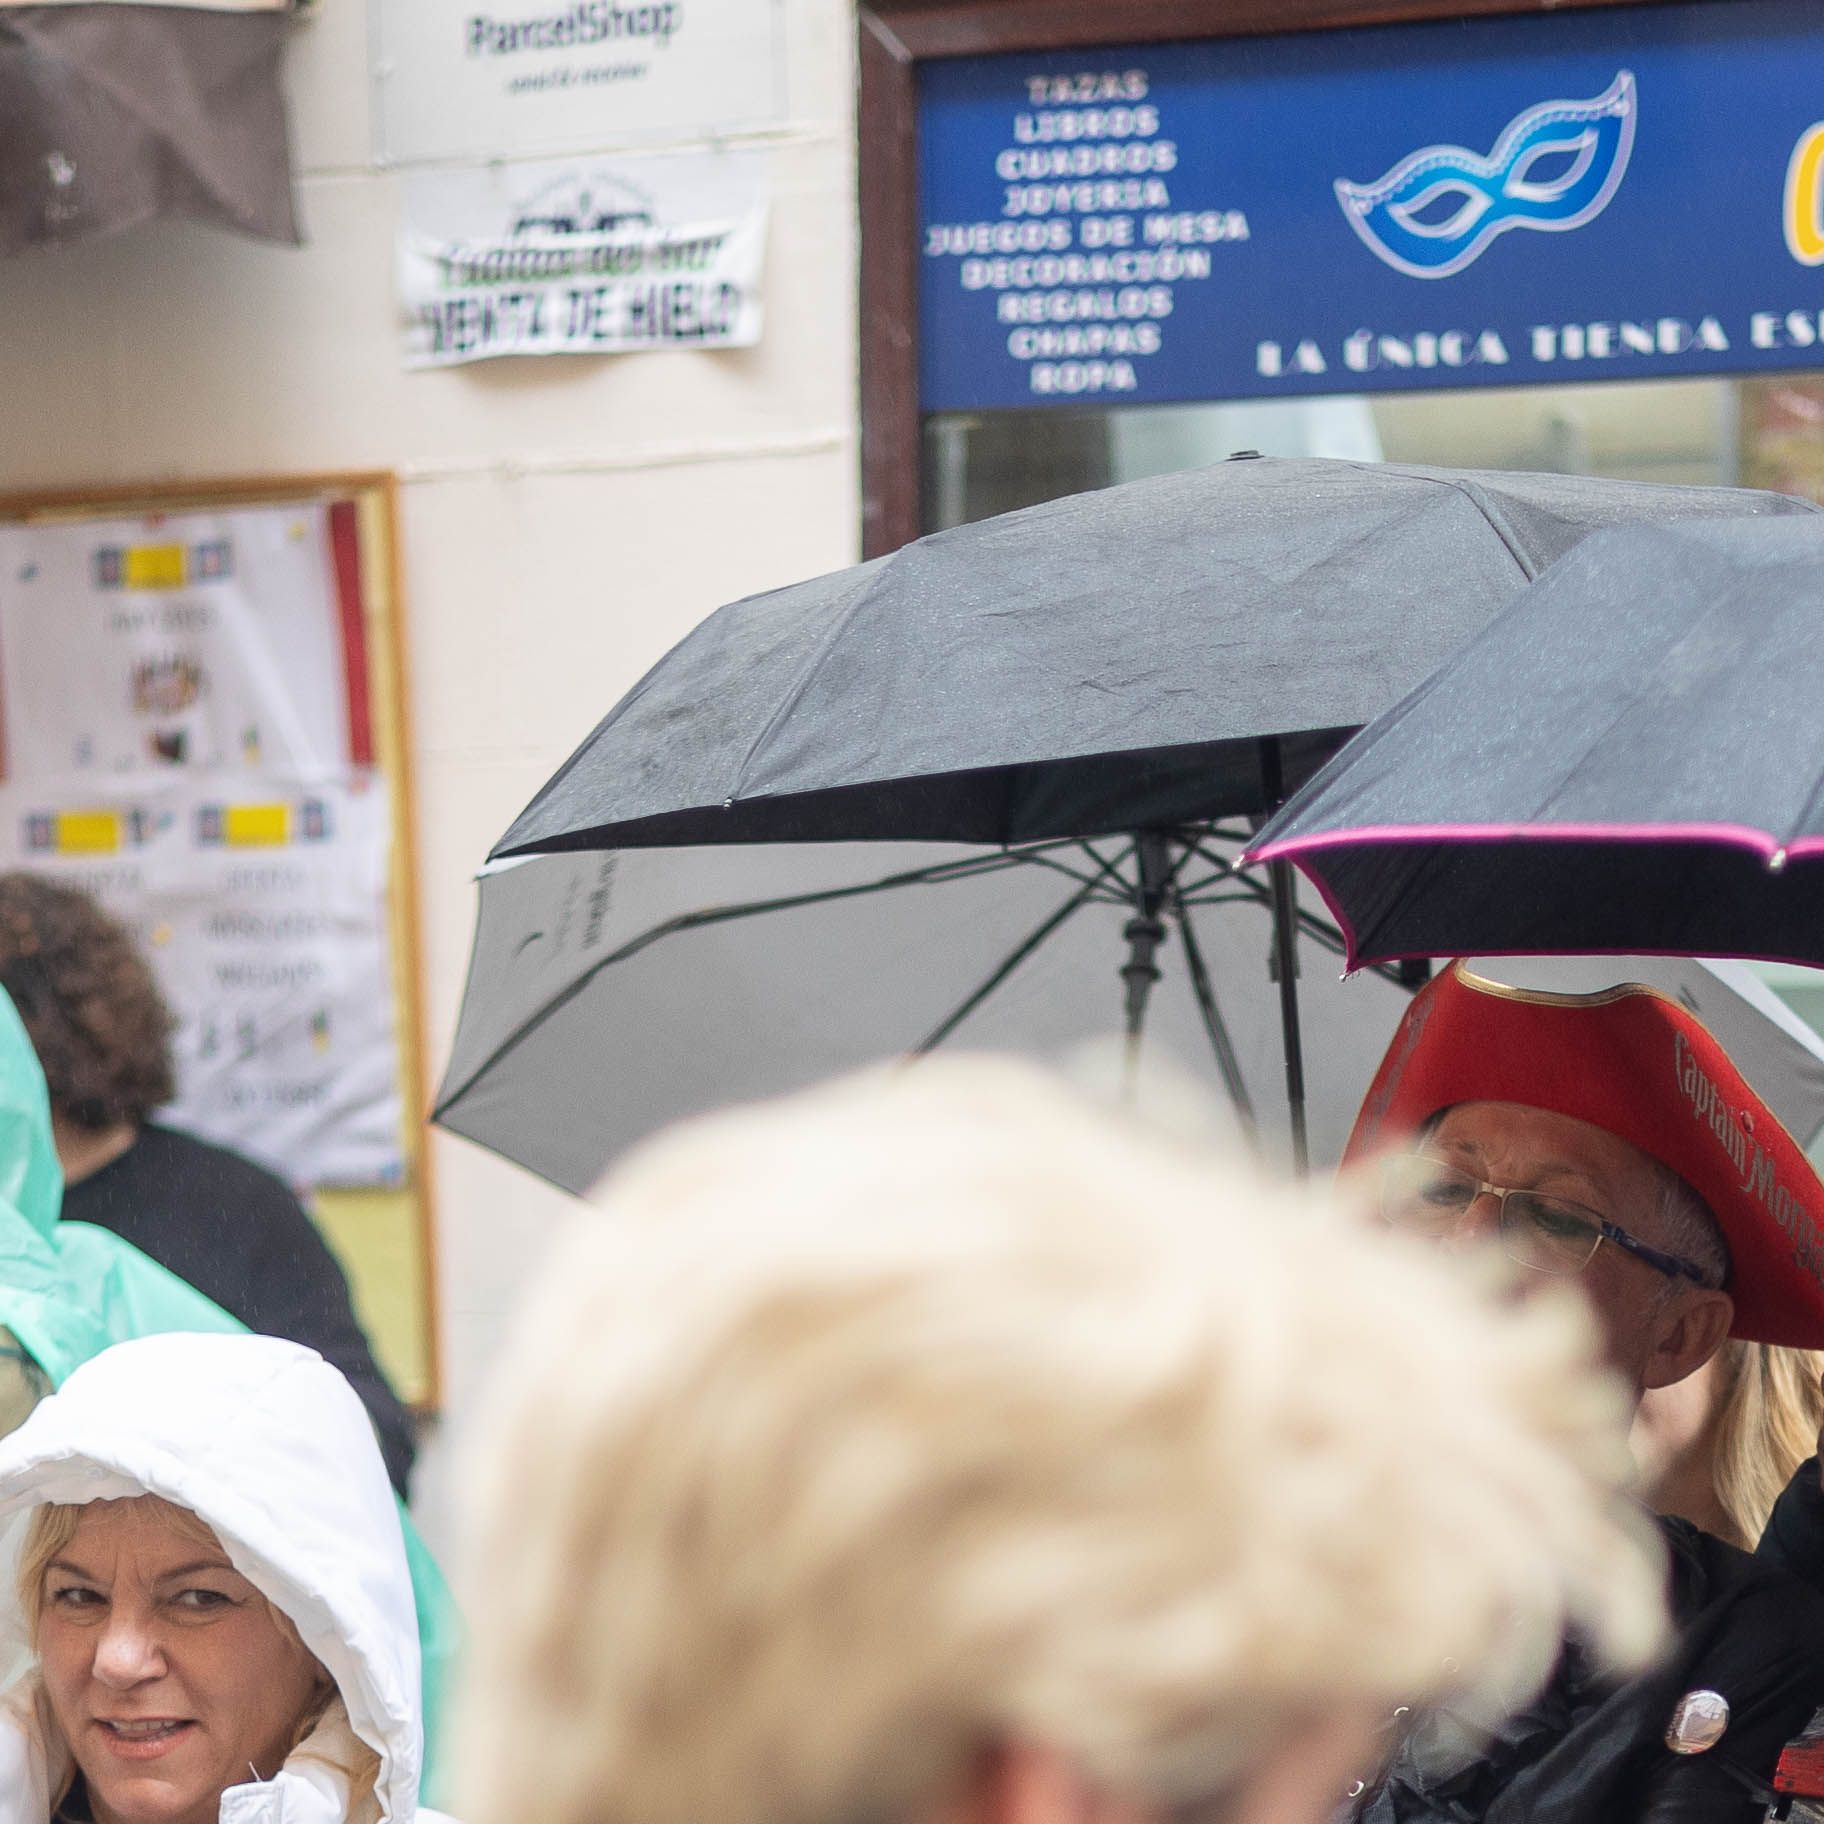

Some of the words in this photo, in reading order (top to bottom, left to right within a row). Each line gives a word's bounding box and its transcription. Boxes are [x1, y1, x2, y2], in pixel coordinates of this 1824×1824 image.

[467, 1, 680, 56] ParcelShop
[1026, 69, 1149, 105] TAZAS
[1014, 104, 1160, 144] LIBROS
[995, 139, 1178, 181] CUADROS
[924, 217, 1073, 256] JUEGOS
[1080, 214, 1135, 248] DE
[1143, 209, 1251, 244] MESA
[960, 241, 1212, 290] DECORACIÓN
[997, 284, 1174, 324] REGALOS
[1008, 320, 1162, 359] CHAPAS
[1256, 339, 1328, 378] LA
[1343, 326, 1510, 373] ÚNICA
[1531, 314, 1731, 362] TIENDA
[1031, 358, 1137, 393] ROPA
[1674, 1029, 1748, 1177] Captain
